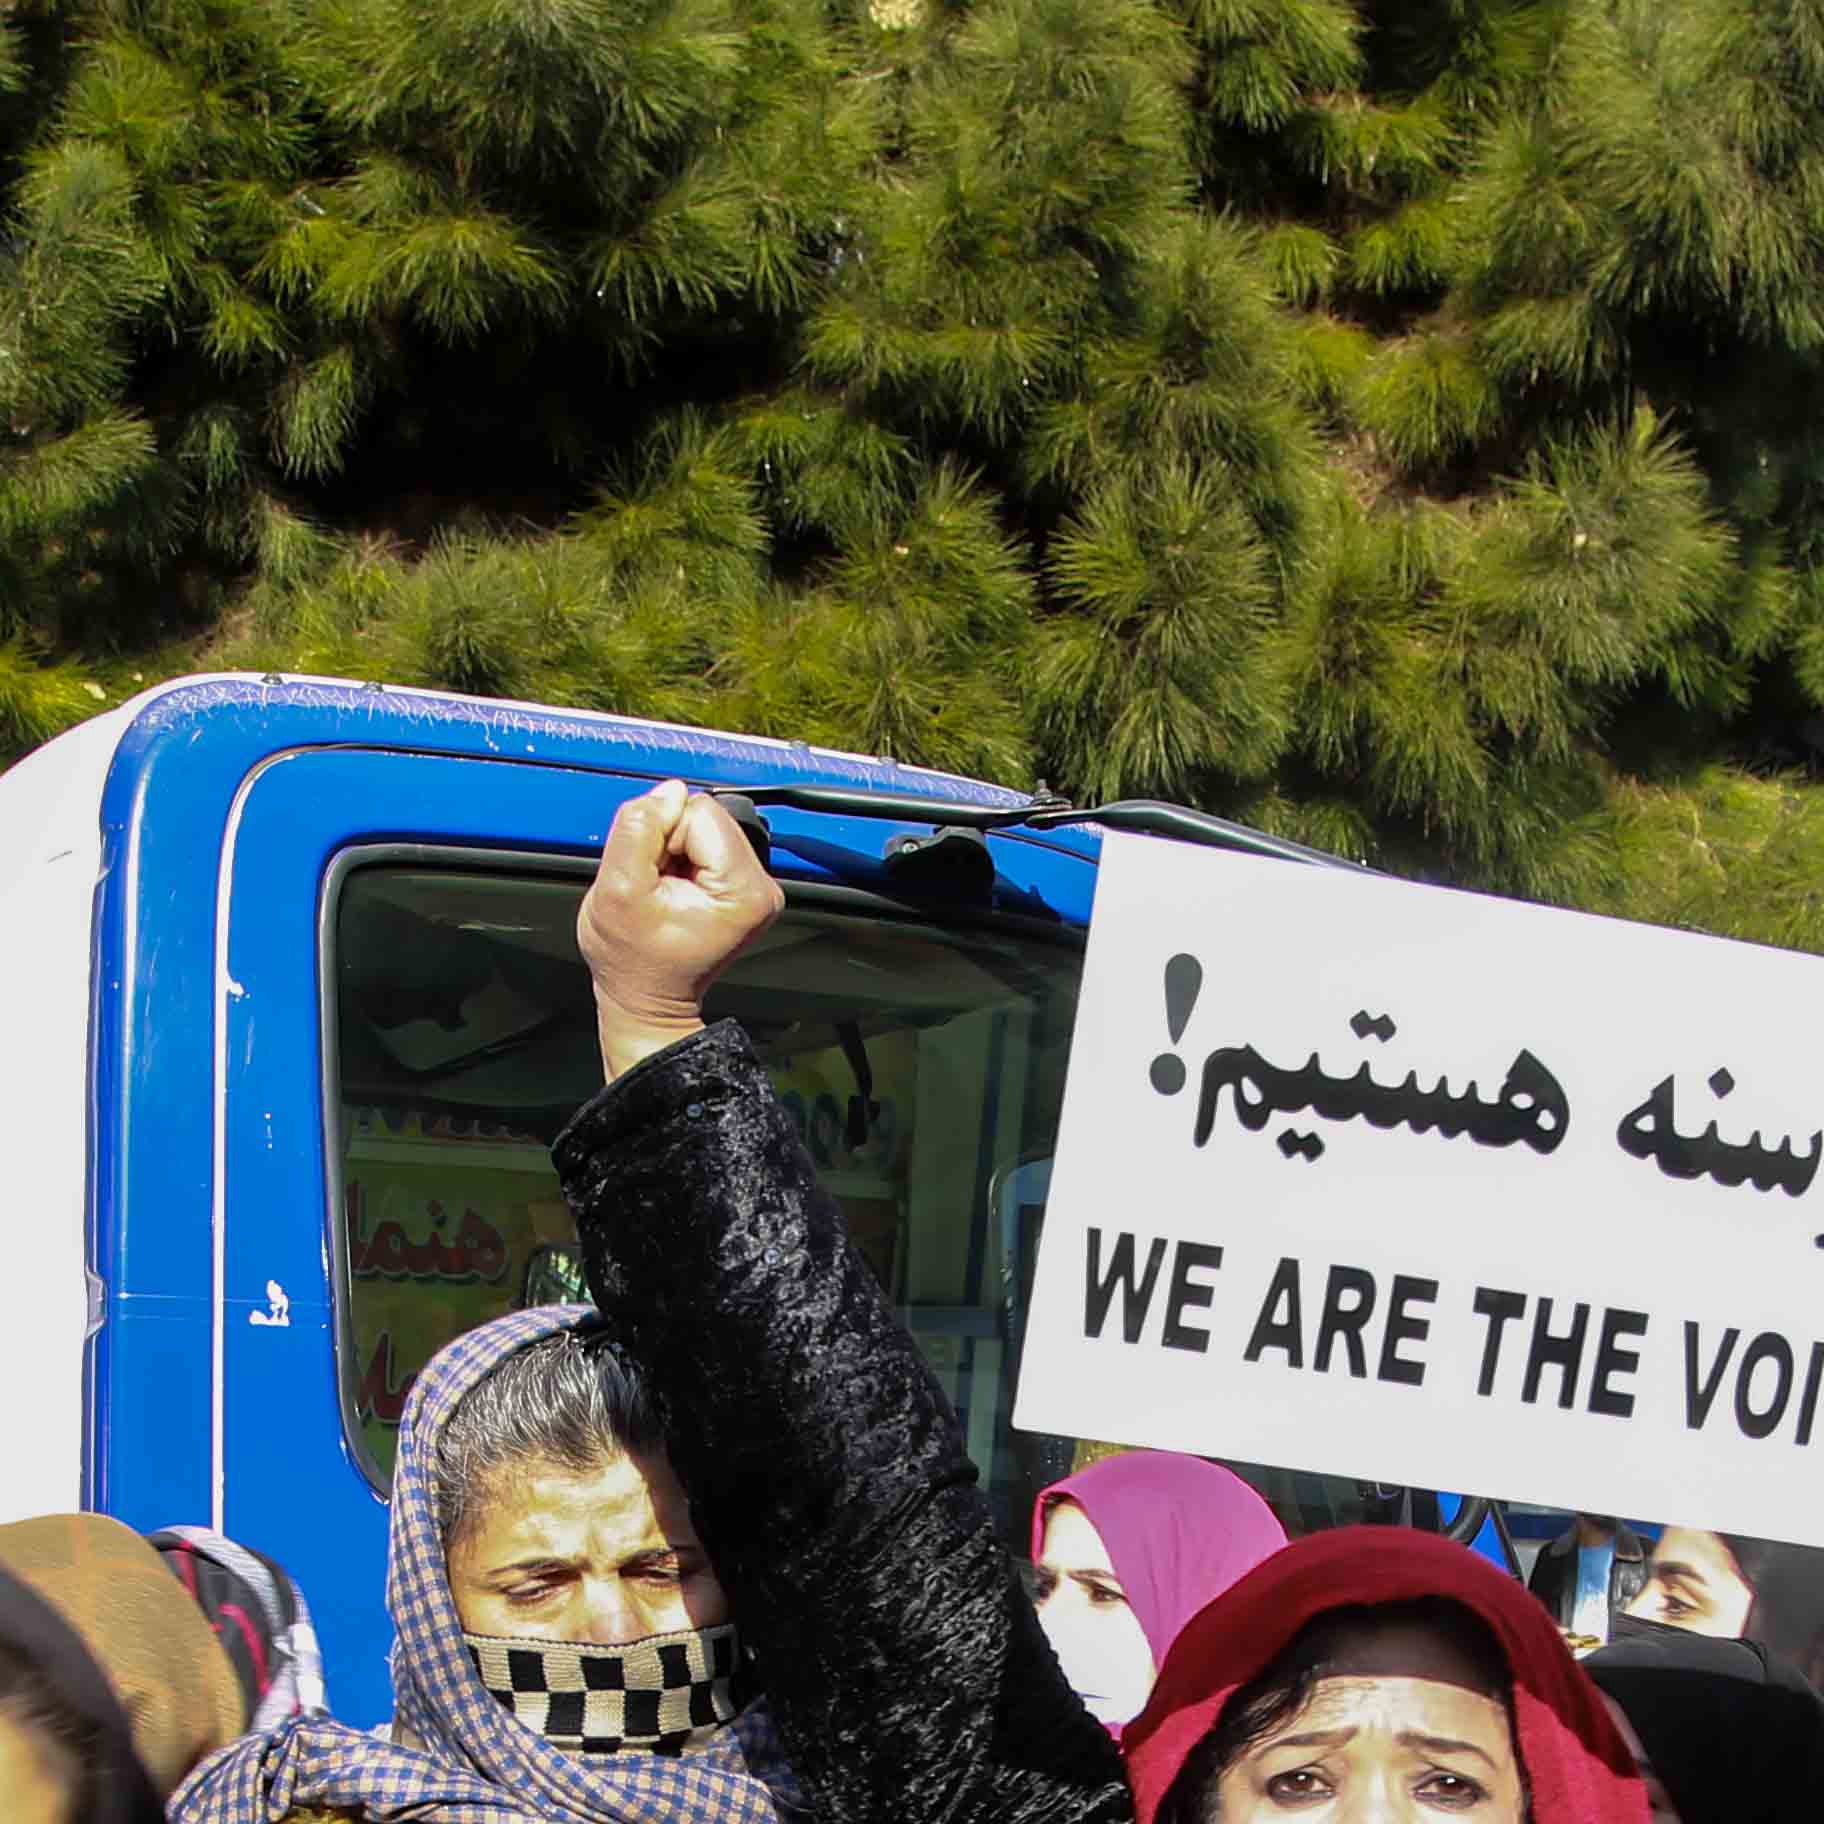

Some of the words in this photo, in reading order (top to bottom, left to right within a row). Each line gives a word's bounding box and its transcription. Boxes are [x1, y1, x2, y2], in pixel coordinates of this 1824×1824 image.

[1149, 952, 1571, 1162] هستیم!
[1083, 1226, 1225, 1353] WE
[1243, 1256, 1440, 1387] ARE
[1473, 1286, 1649, 1418] THE
